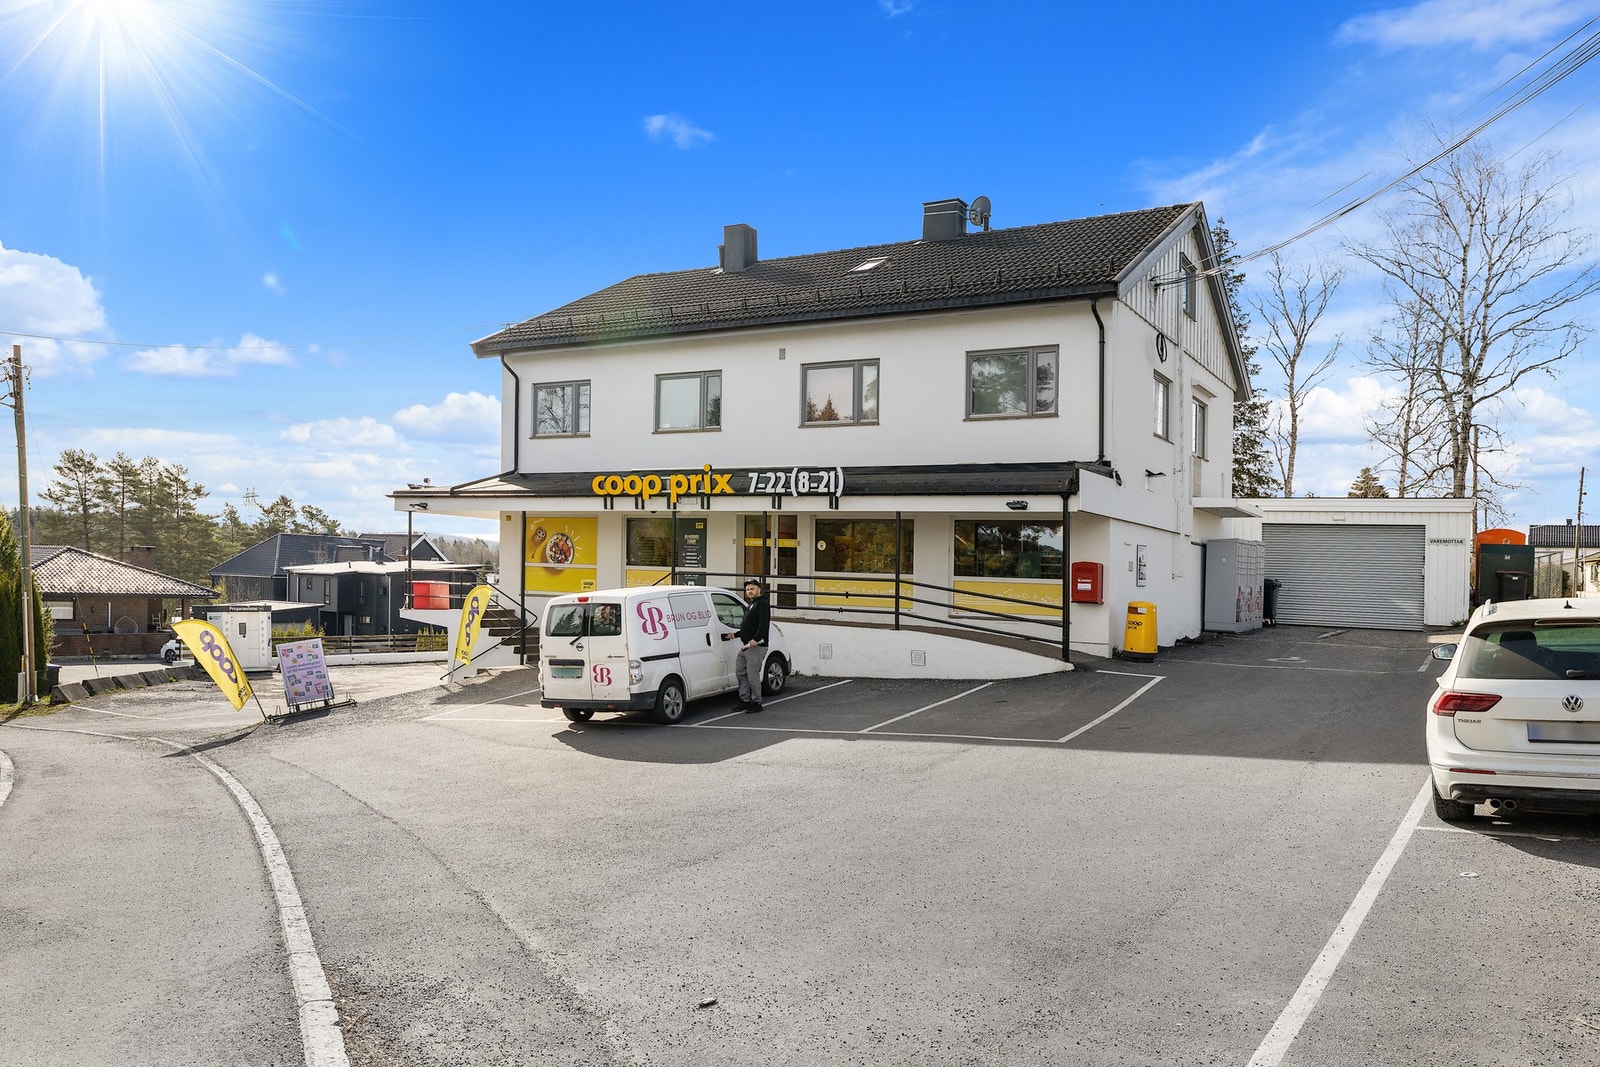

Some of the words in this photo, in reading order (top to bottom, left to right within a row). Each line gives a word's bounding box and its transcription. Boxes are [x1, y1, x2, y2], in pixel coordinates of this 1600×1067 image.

[592, 474, 662, 500] coop
[670, 464, 734, 503] prix
[748, 472, 786, 494] 7-22
[666, 613, 686, 623] BRUN
[686, 611, 697, 621] OG
[698, 610, 712, 619] BLID
[200, 630, 238, 684] coop
